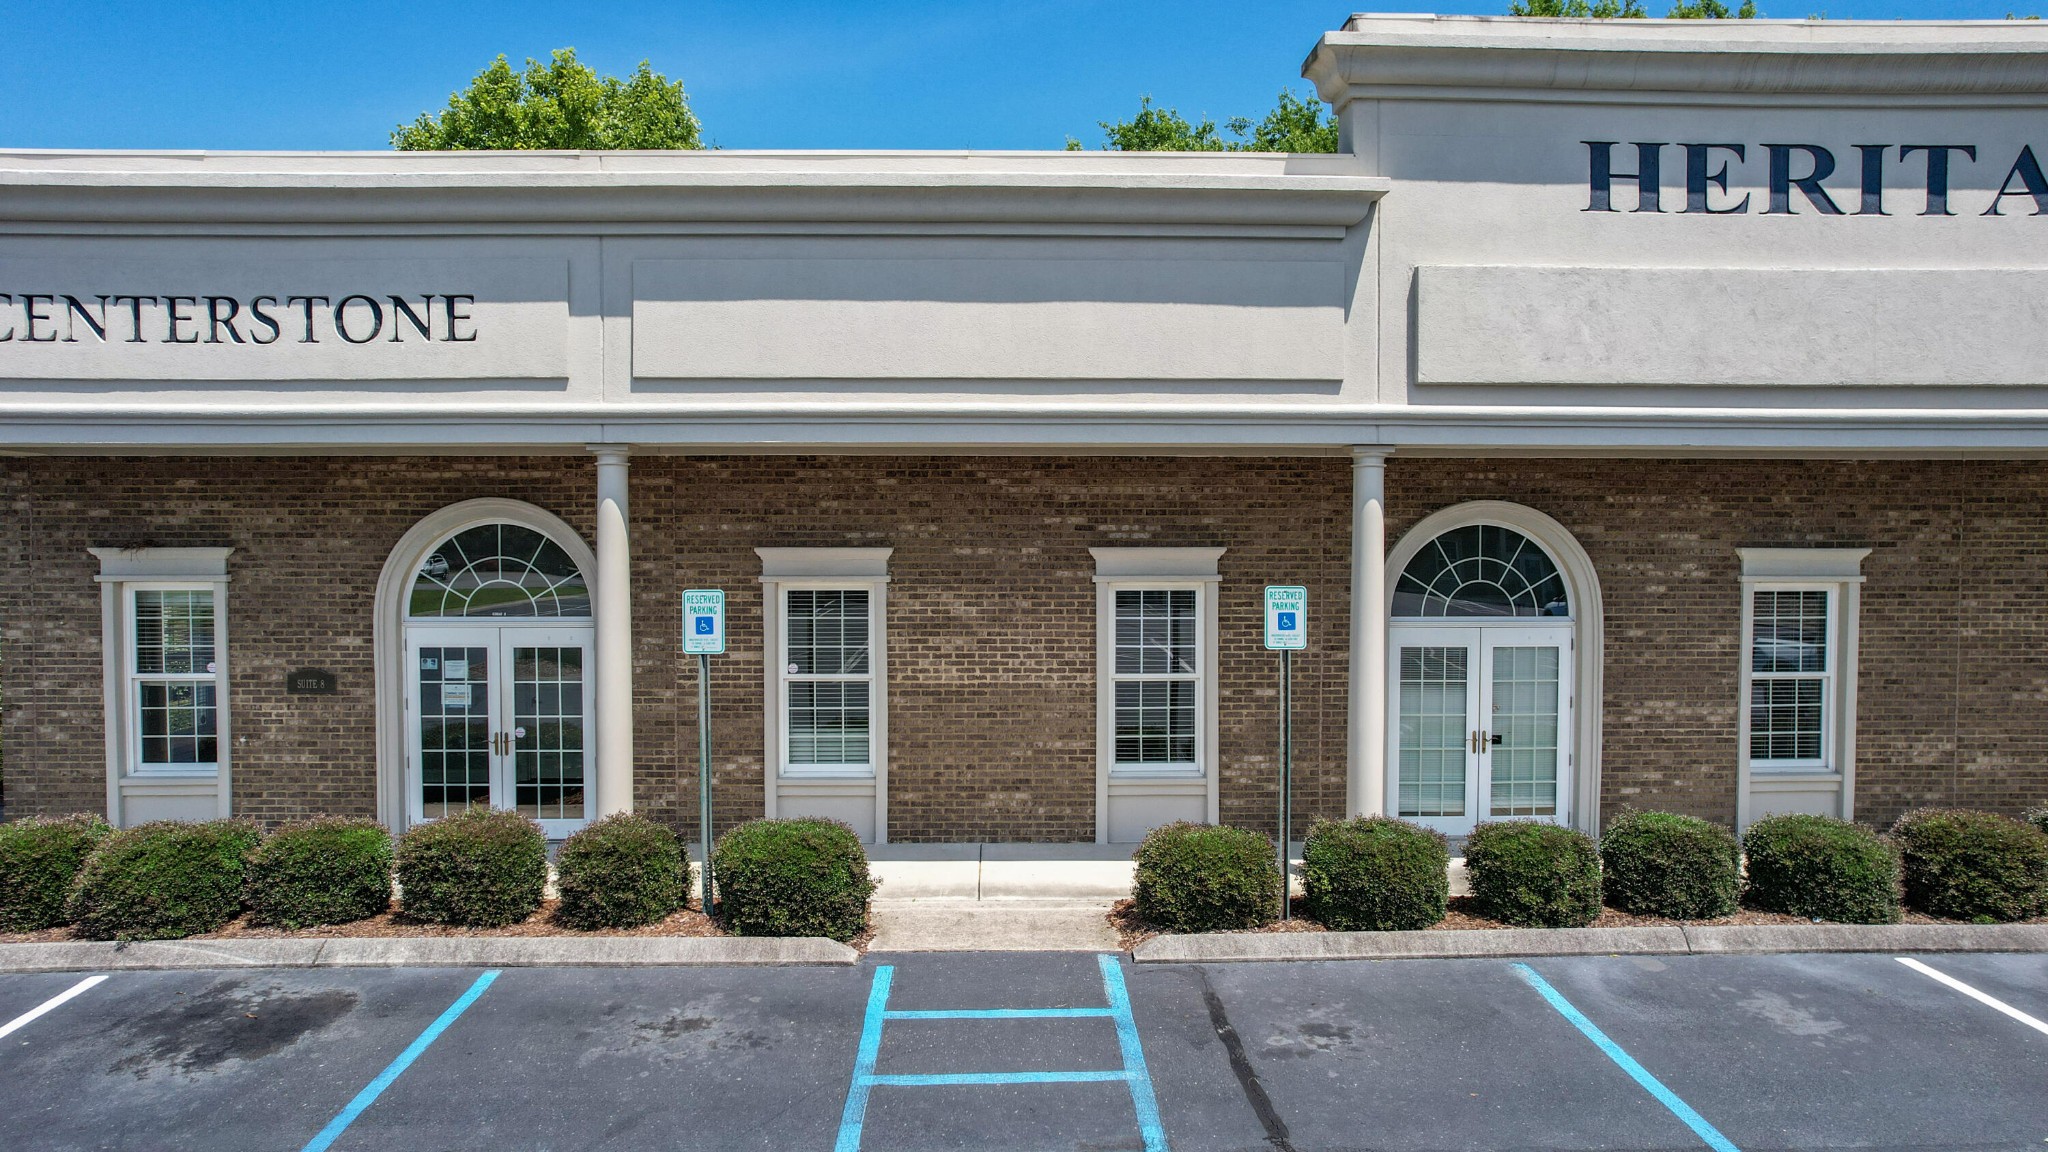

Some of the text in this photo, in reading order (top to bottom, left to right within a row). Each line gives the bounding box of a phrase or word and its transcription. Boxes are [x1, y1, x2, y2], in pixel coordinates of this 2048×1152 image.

[1580, 141, 2048, 216] HERITA
[687, 595, 720, 604] RESERVED
[1269, 591, 1303, 600] RESERVED
[690, 606, 717, 615] PARKING
[1272, 602, 1299, 610] PARKING
[297, 679, 325, 689] SUITE 8
